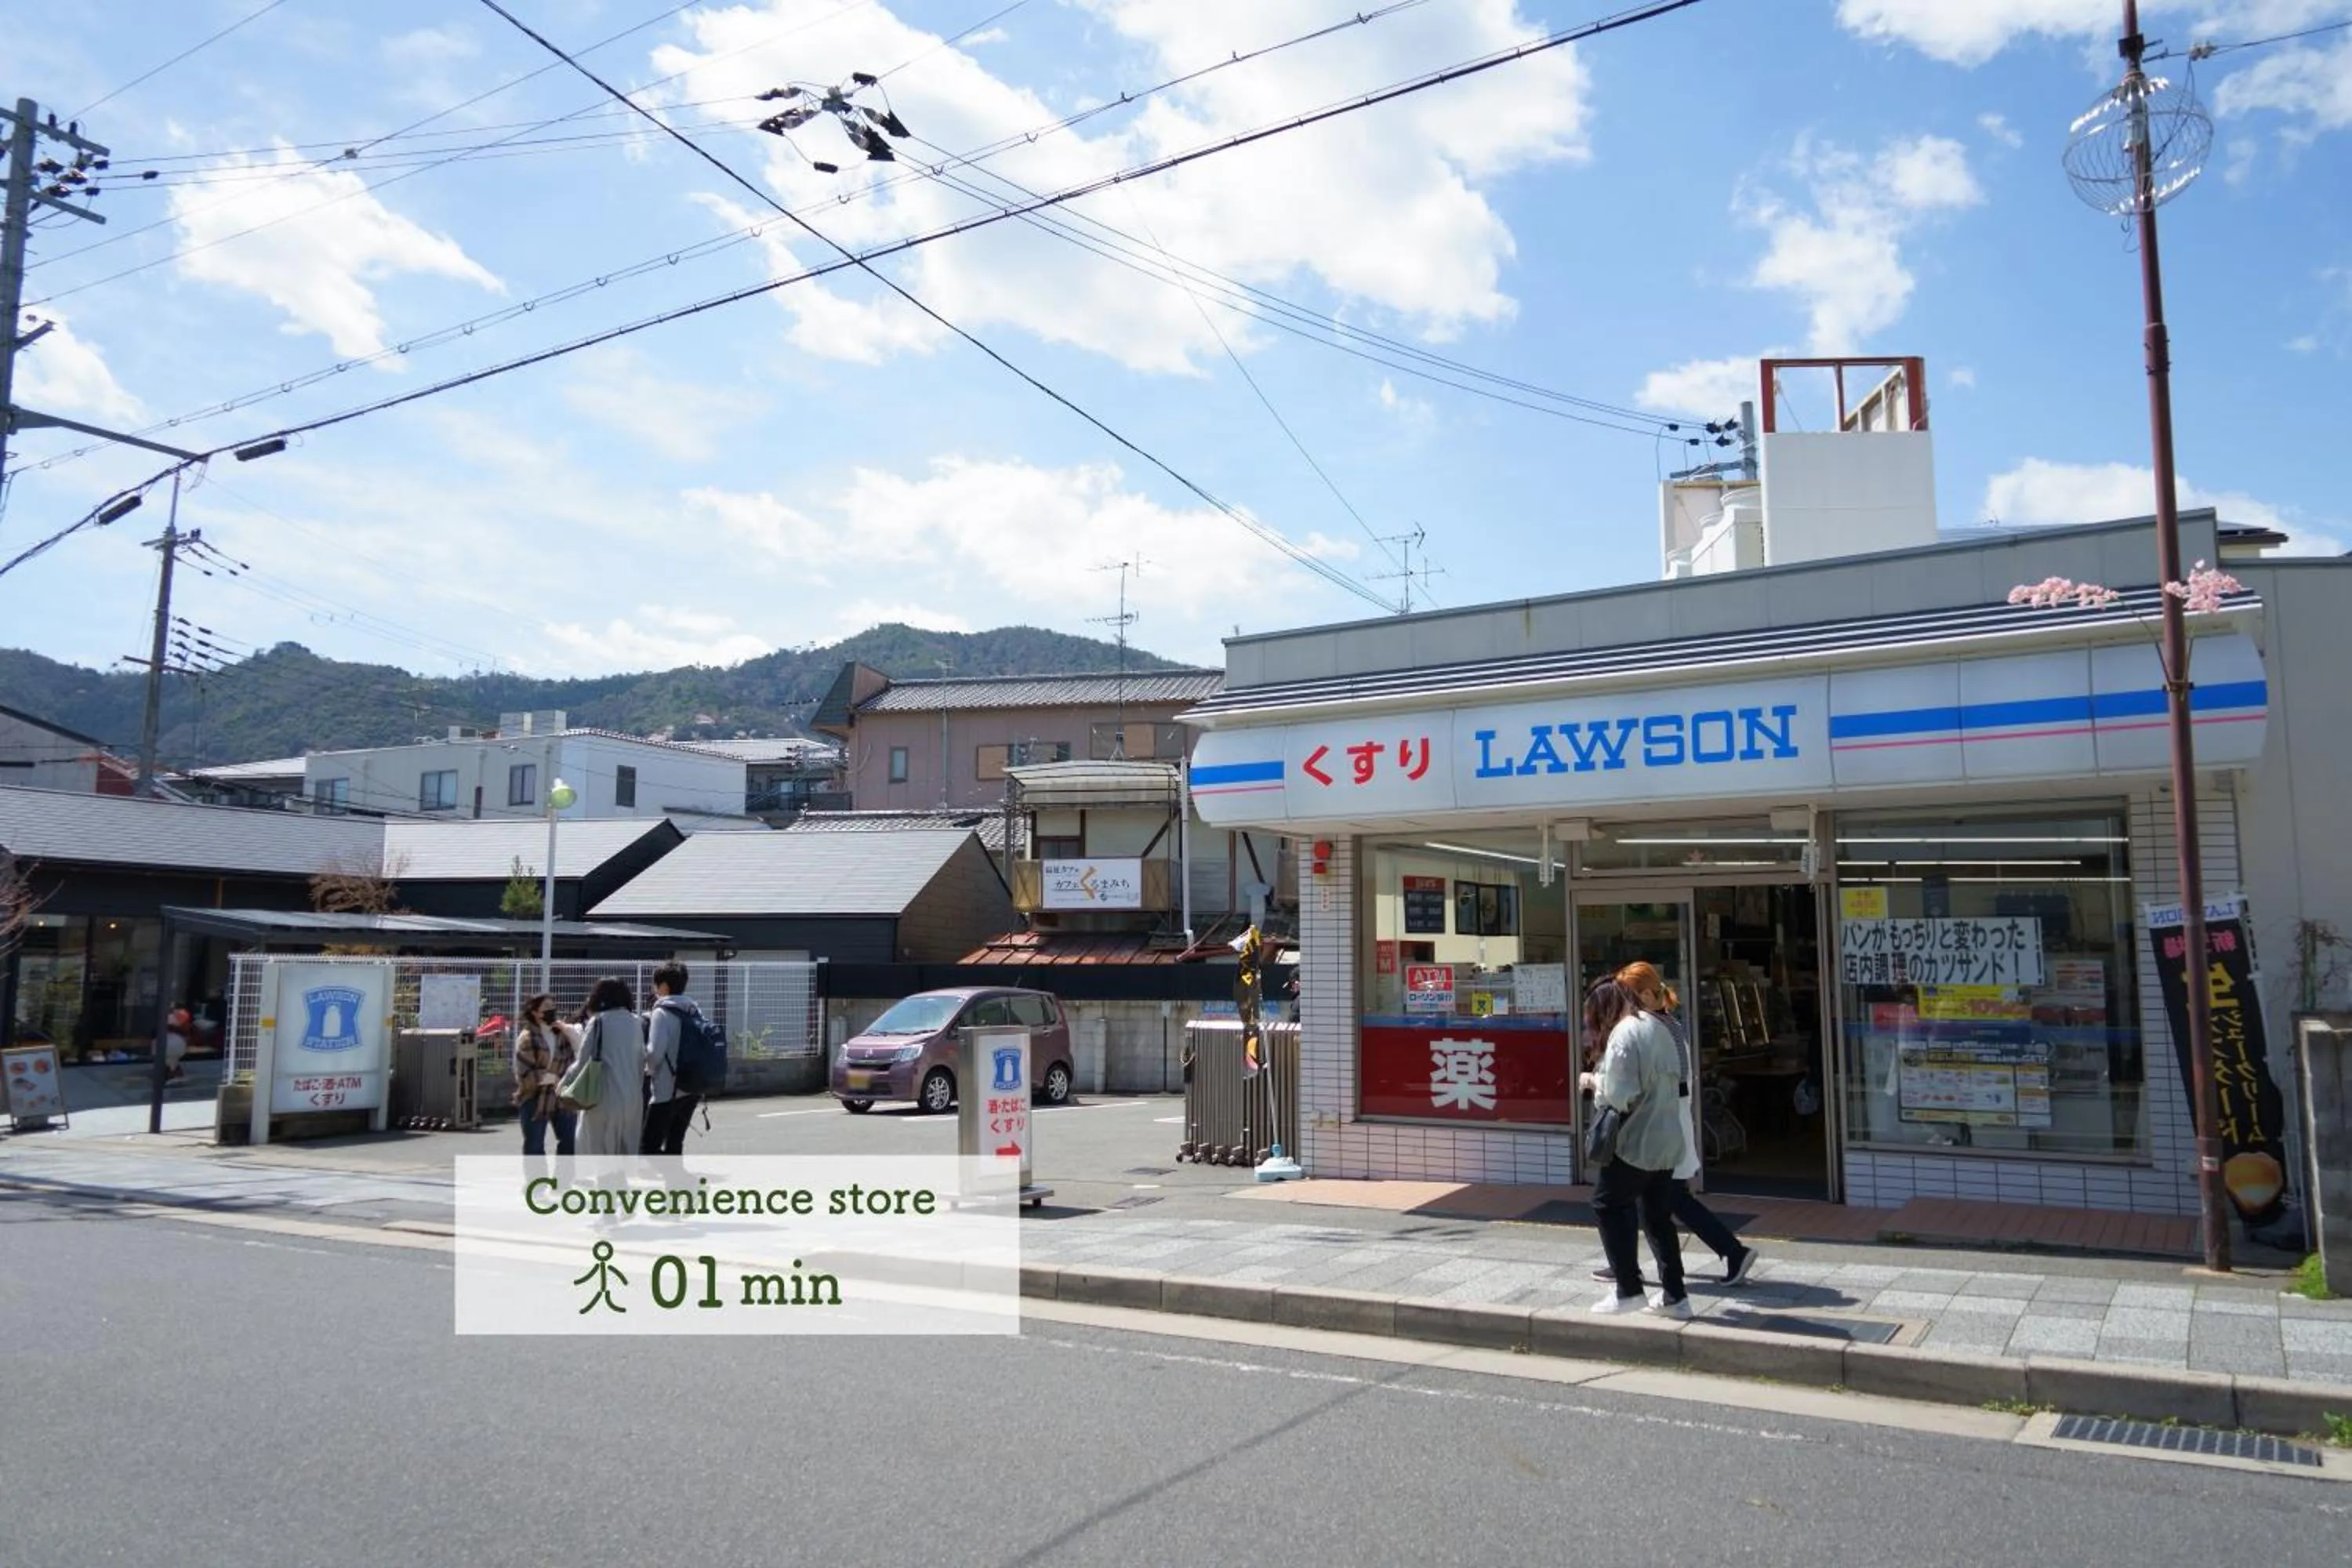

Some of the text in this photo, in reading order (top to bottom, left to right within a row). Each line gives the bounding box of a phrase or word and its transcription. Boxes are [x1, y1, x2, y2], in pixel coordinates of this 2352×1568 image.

[1475, 705, 1798, 778] LAWSON
[1302, 737, 1430, 786] くすり
[1414, 968, 1446, 982] ATM
[1429, 1037, 1497, 1110] 薬
[310, 1092, 345, 1106] くすり
[991, 1116, 1025, 1134] くすり
